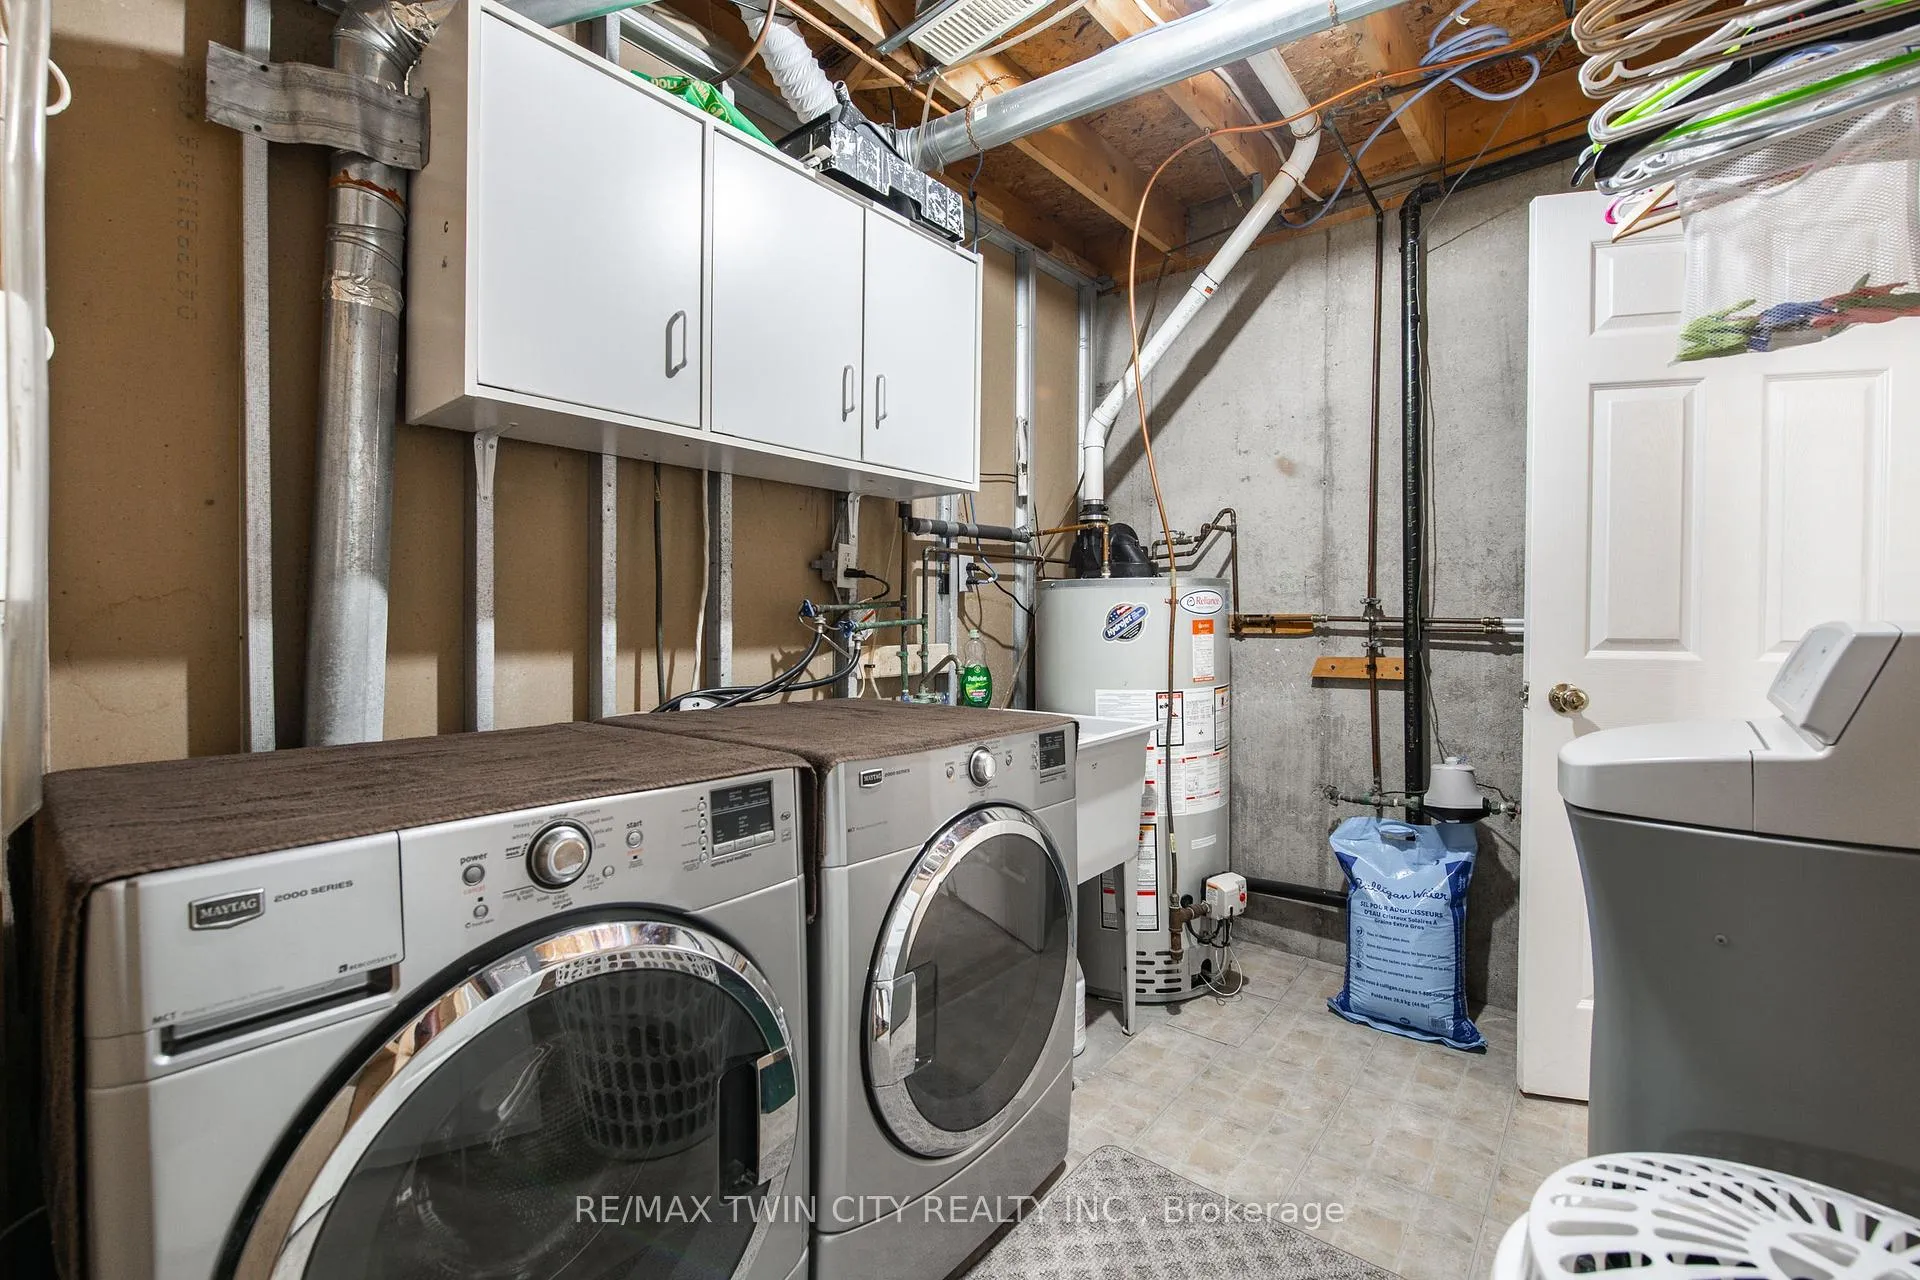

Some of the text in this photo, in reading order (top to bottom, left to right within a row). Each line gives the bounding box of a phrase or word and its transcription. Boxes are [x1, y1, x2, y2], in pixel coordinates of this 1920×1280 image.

[626, 819, 642, 829] start
[460, 852, 488, 866] power
[200, 880, 354, 920] MAYTAG 2000 SERIES
